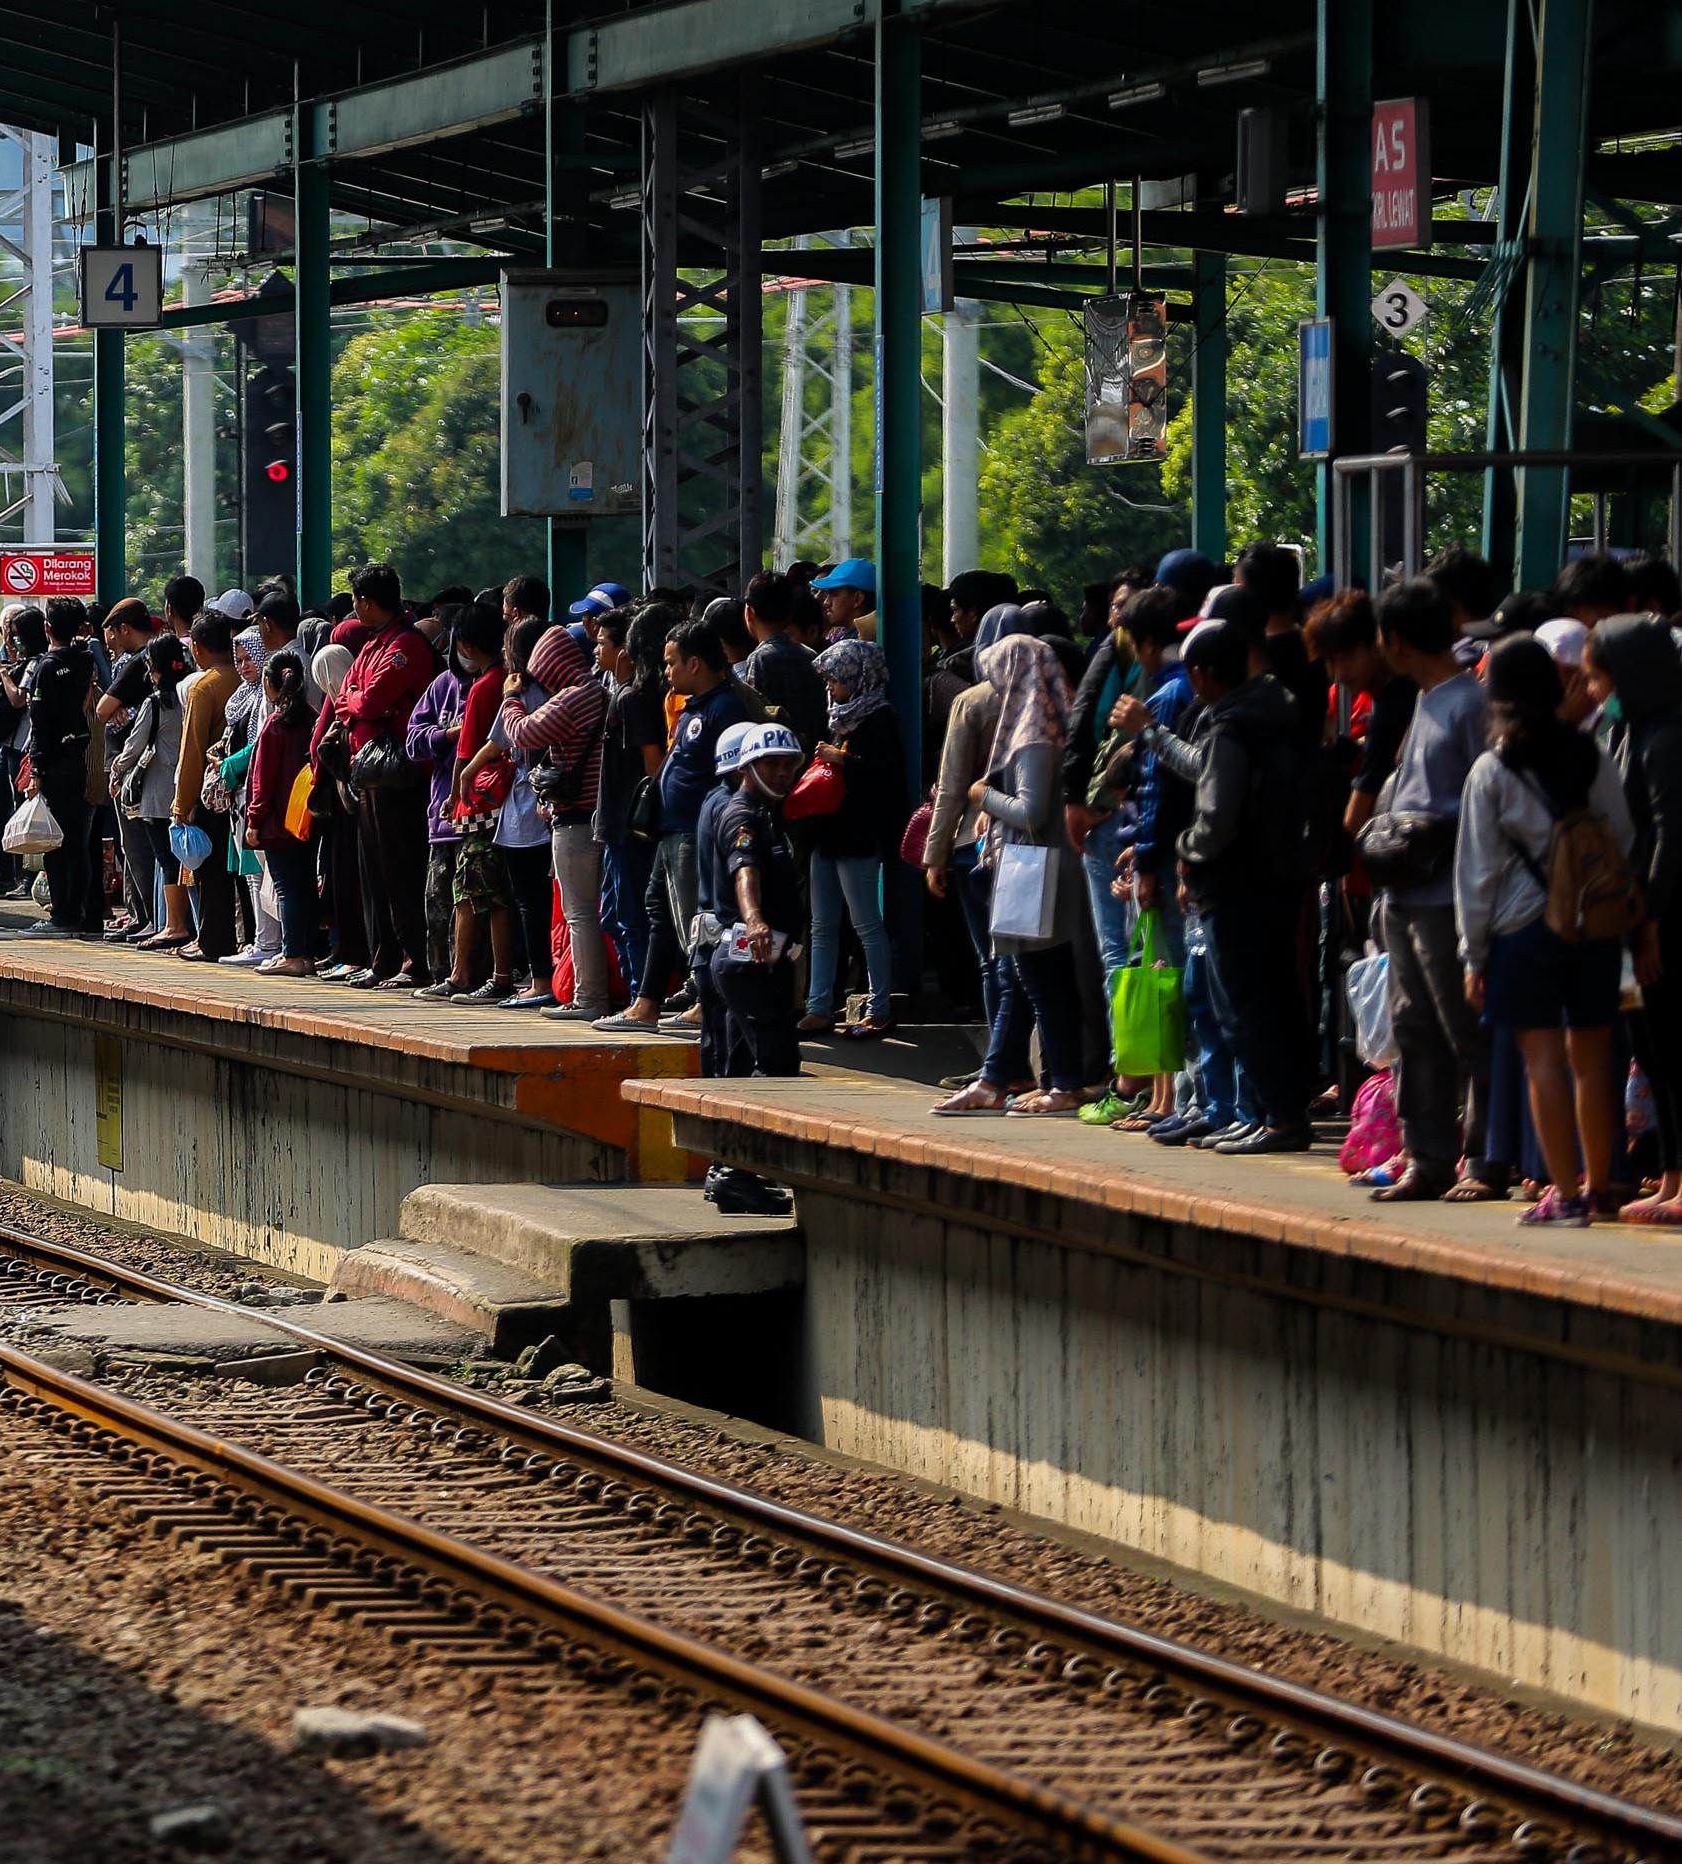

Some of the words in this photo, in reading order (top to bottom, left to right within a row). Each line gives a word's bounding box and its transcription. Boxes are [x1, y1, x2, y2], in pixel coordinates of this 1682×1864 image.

[104, 263, 138, 311] 4
[1385, 292, 1408, 328] 3
[43, 559, 92, 571] Dilarang
[43, 570, 91, 580] Merokok
